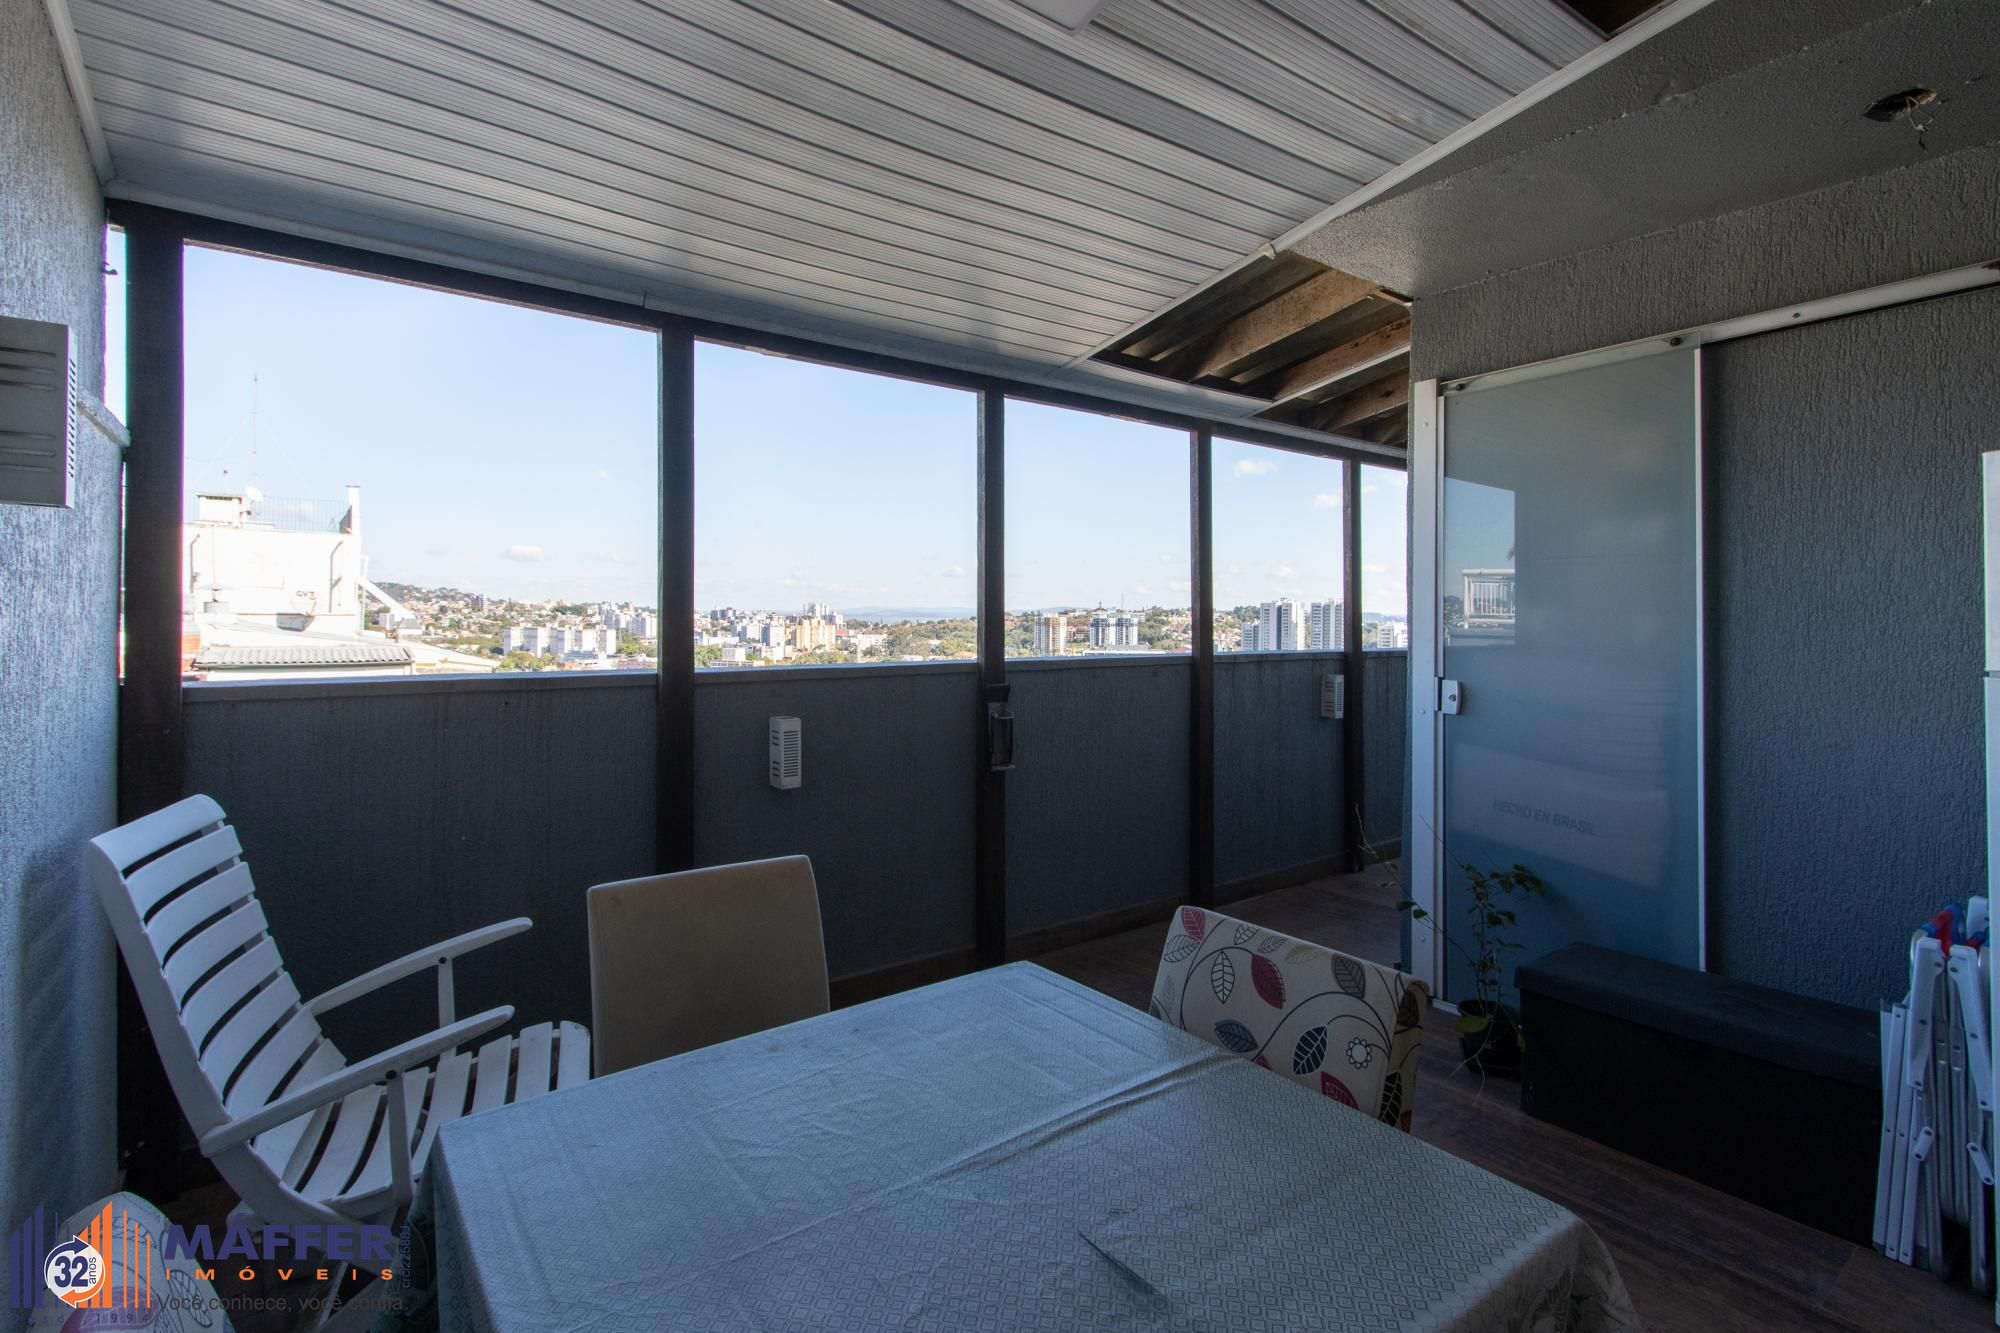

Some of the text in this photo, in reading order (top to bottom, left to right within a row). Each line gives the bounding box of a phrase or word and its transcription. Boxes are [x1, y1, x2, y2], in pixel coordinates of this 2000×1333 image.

[1494, 800, 1597, 837] HECHO EN BRASIL
